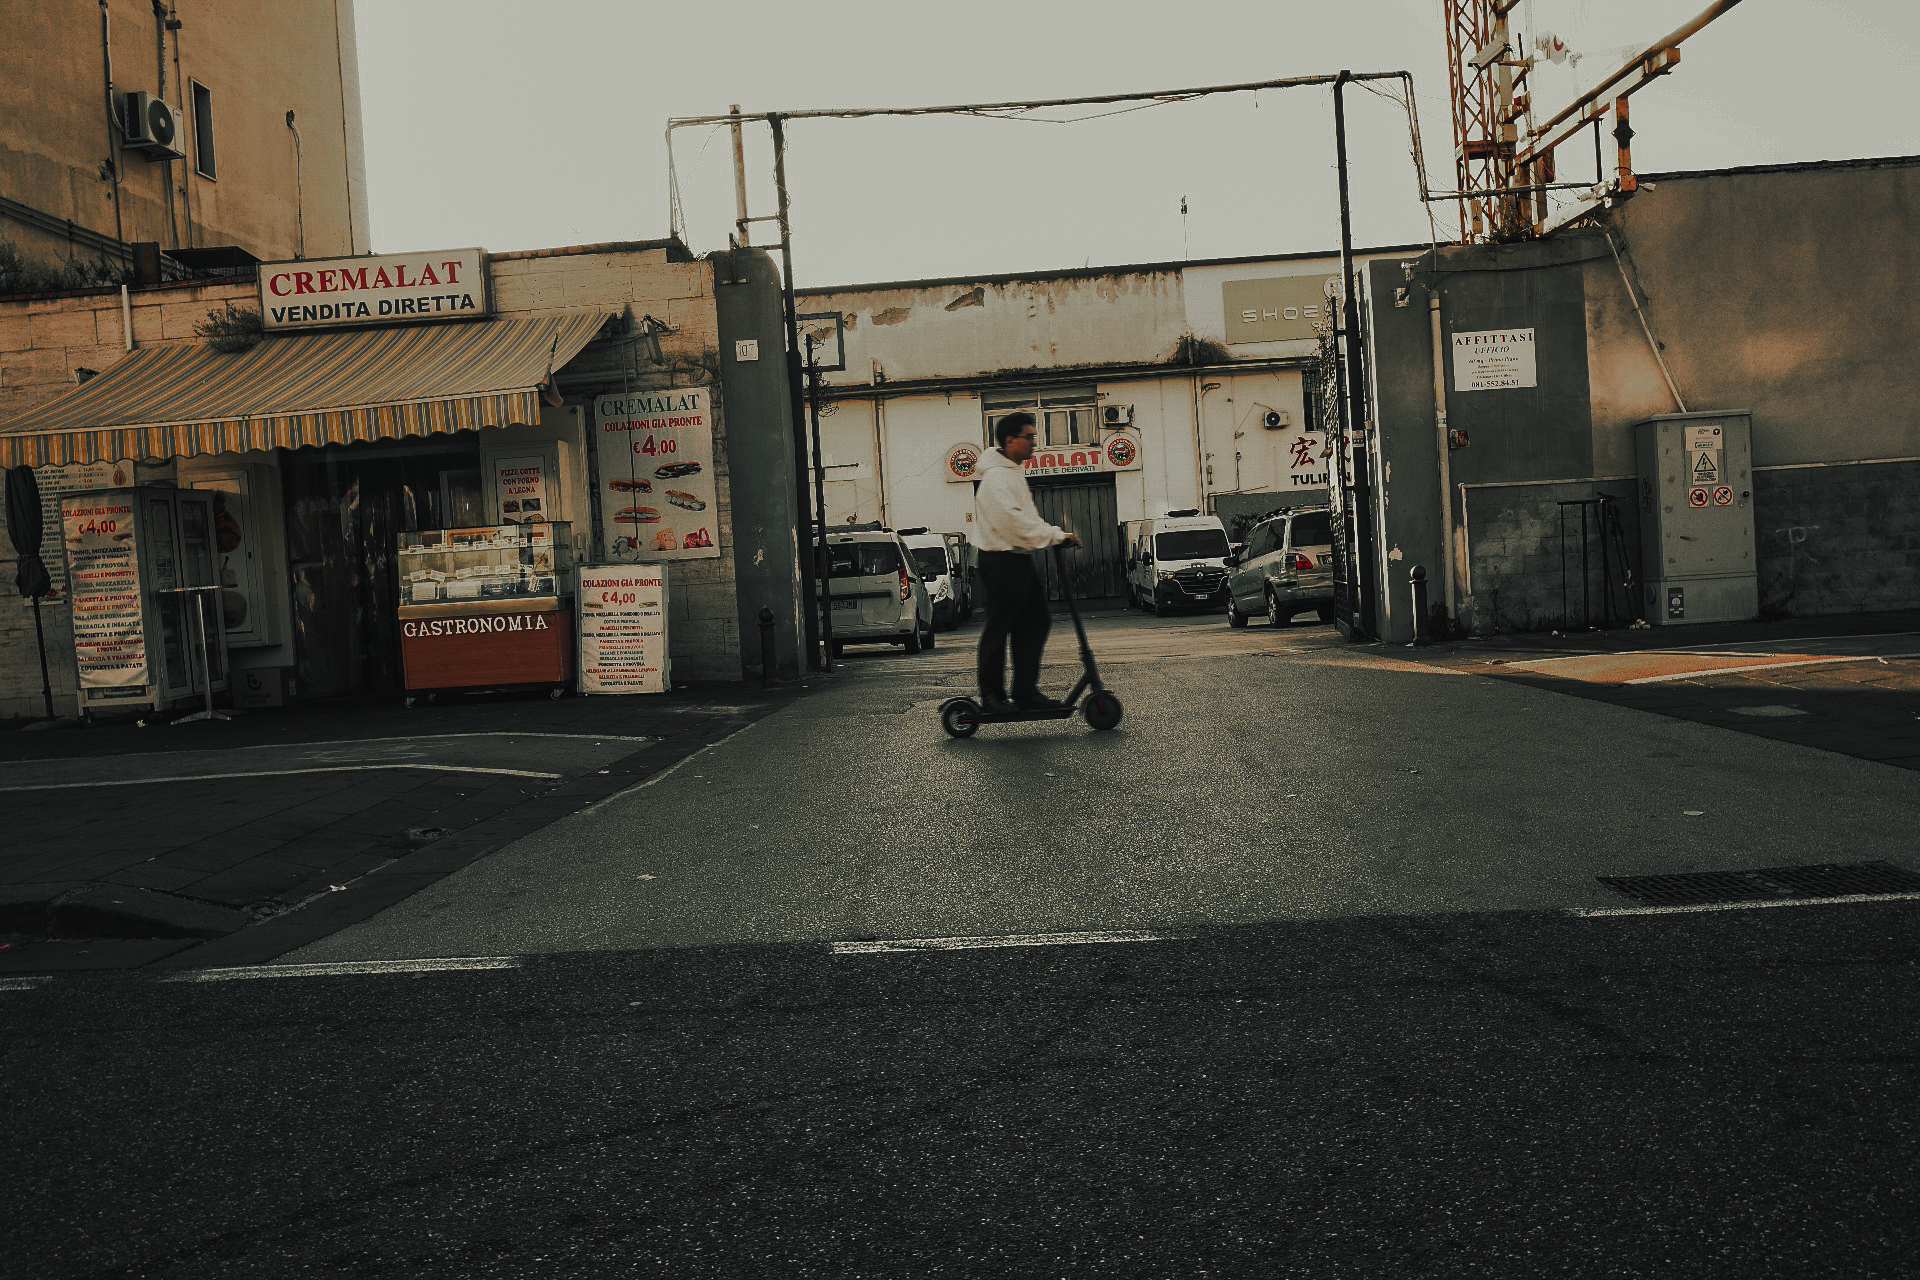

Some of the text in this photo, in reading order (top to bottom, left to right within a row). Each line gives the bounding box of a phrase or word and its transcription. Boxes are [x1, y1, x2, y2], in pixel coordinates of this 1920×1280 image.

[269, 261, 462, 296] CREMALAT
[271, 294, 475, 323] VENDITA DIRETTA
[1456, 333, 1532, 346] AFFITTASI
[1474, 346, 1509, 354] UFFICIO
[601, 394, 699, 416] CREMALAT
[605, 420, 650, 432] COLAZIONI
[669, 416, 702, 427] PRONTE
[520, 467, 540, 475] COTTE
[1024, 468, 1050, 476] LATTE
[1061, 465, 1095, 473] DERIVATI
[518, 476, 539, 484] FORNO
[514, 486, 535, 494] LEGNA
[107, 506, 131, 514] PRONTE
[583, 579, 620, 588] COLAZIONI
[635, 578, 662, 586] PRONTE
[403, 614, 548, 637] GASTRONOMIA
